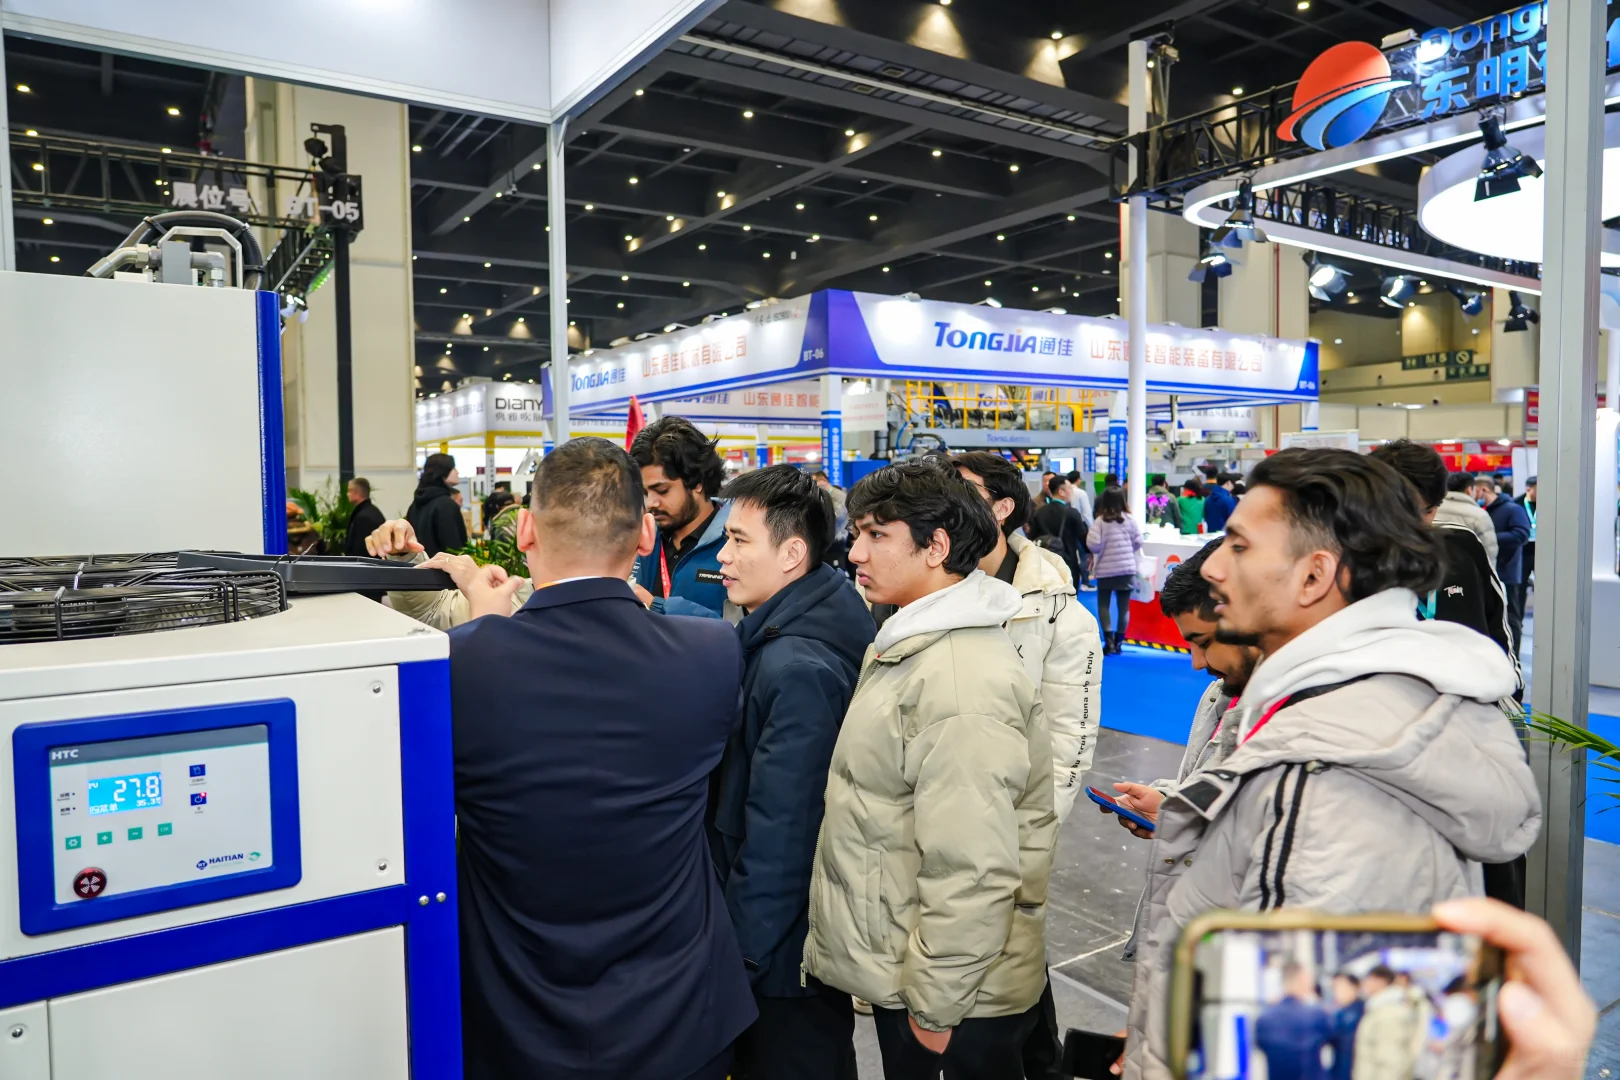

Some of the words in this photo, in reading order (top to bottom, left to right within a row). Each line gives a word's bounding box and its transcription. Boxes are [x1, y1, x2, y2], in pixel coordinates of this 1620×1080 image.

[803, 348, 825, 362] BT-06
[51, 749, 79, 761] HTC
[113, 775, 160, 803] 27.8
[209, 853, 244, 865] HAITIAN
